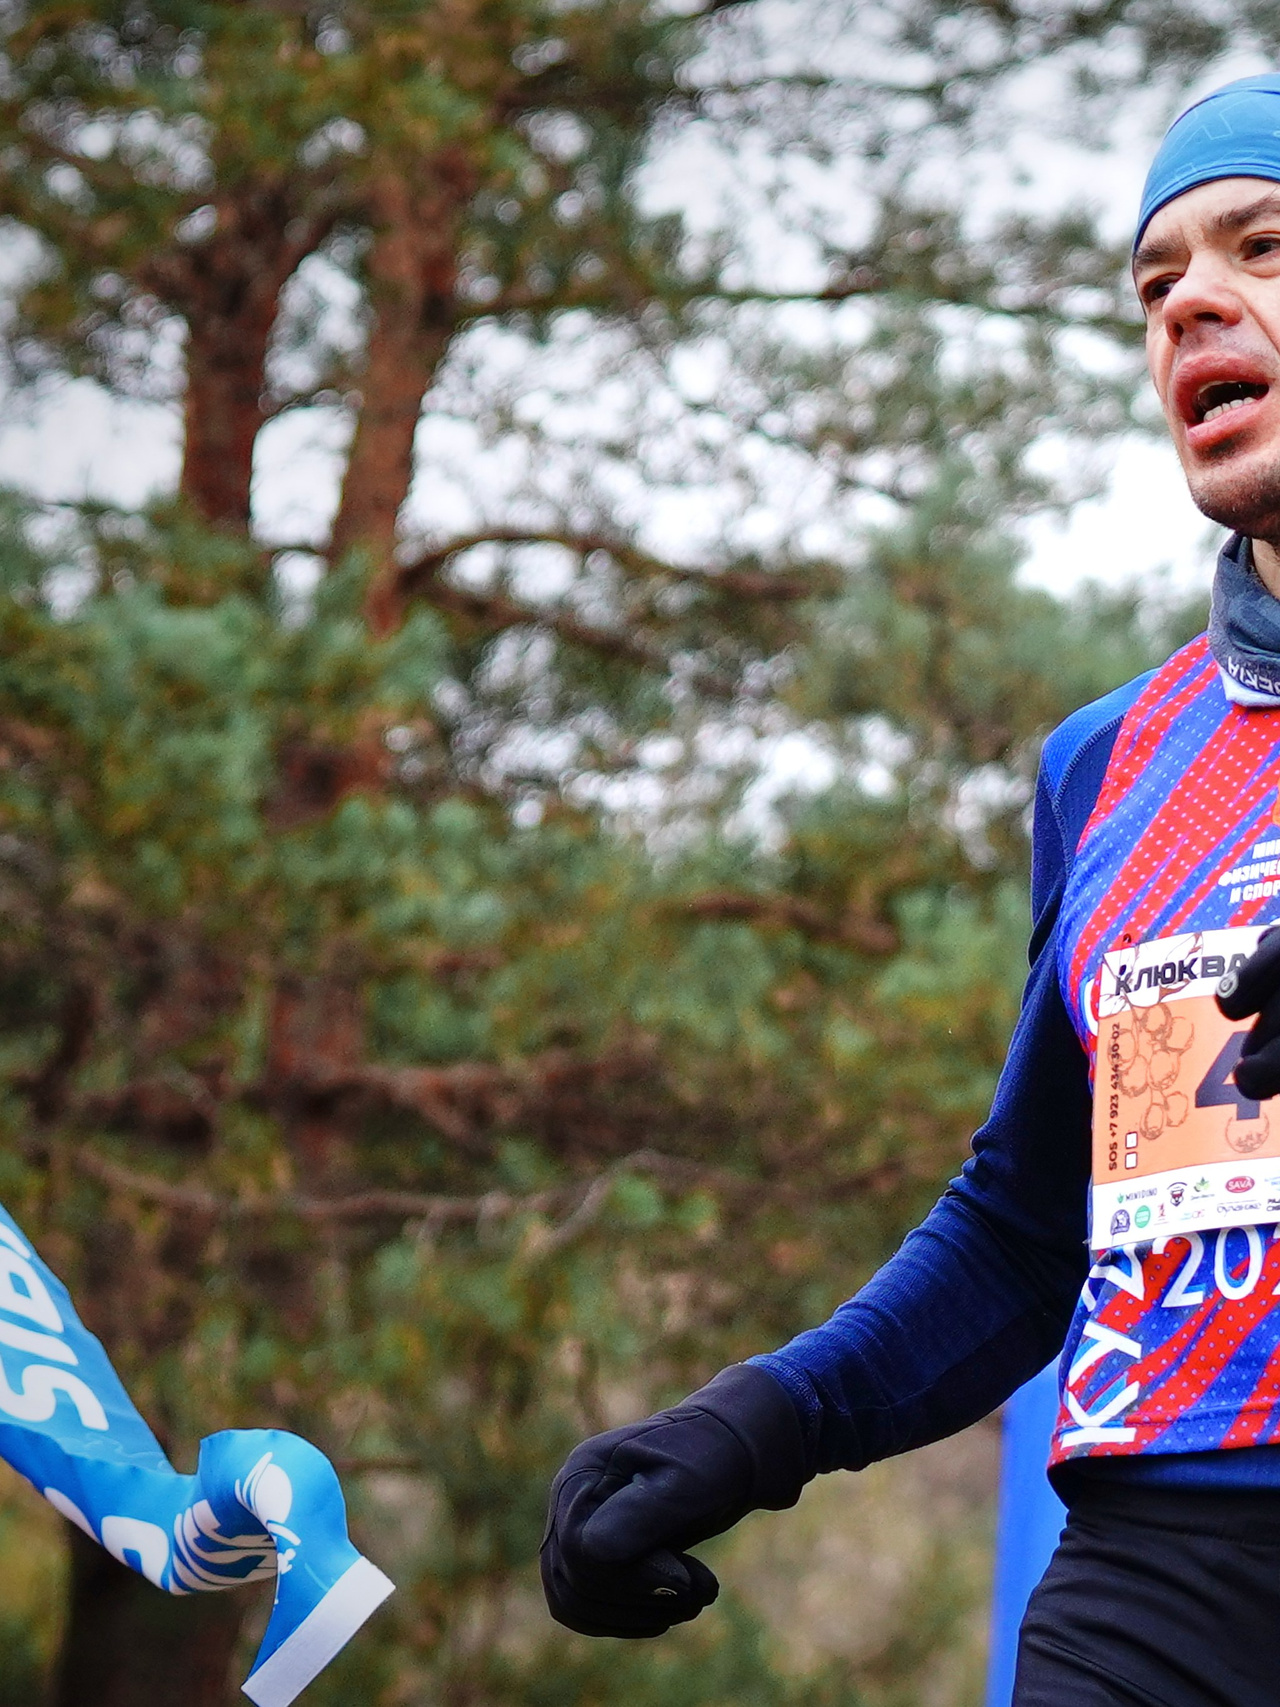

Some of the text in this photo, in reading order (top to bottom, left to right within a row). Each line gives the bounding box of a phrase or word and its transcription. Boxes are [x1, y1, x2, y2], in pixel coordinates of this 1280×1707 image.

[1230, 887, 1242, 903] И
[1110, 1063, 1120, 1090] 434
[1109, 1094, 1119, 1119] 923
[1109, 1122, 1119, 1138] +7
[1108, 1142, 1118, 1171] SOS
